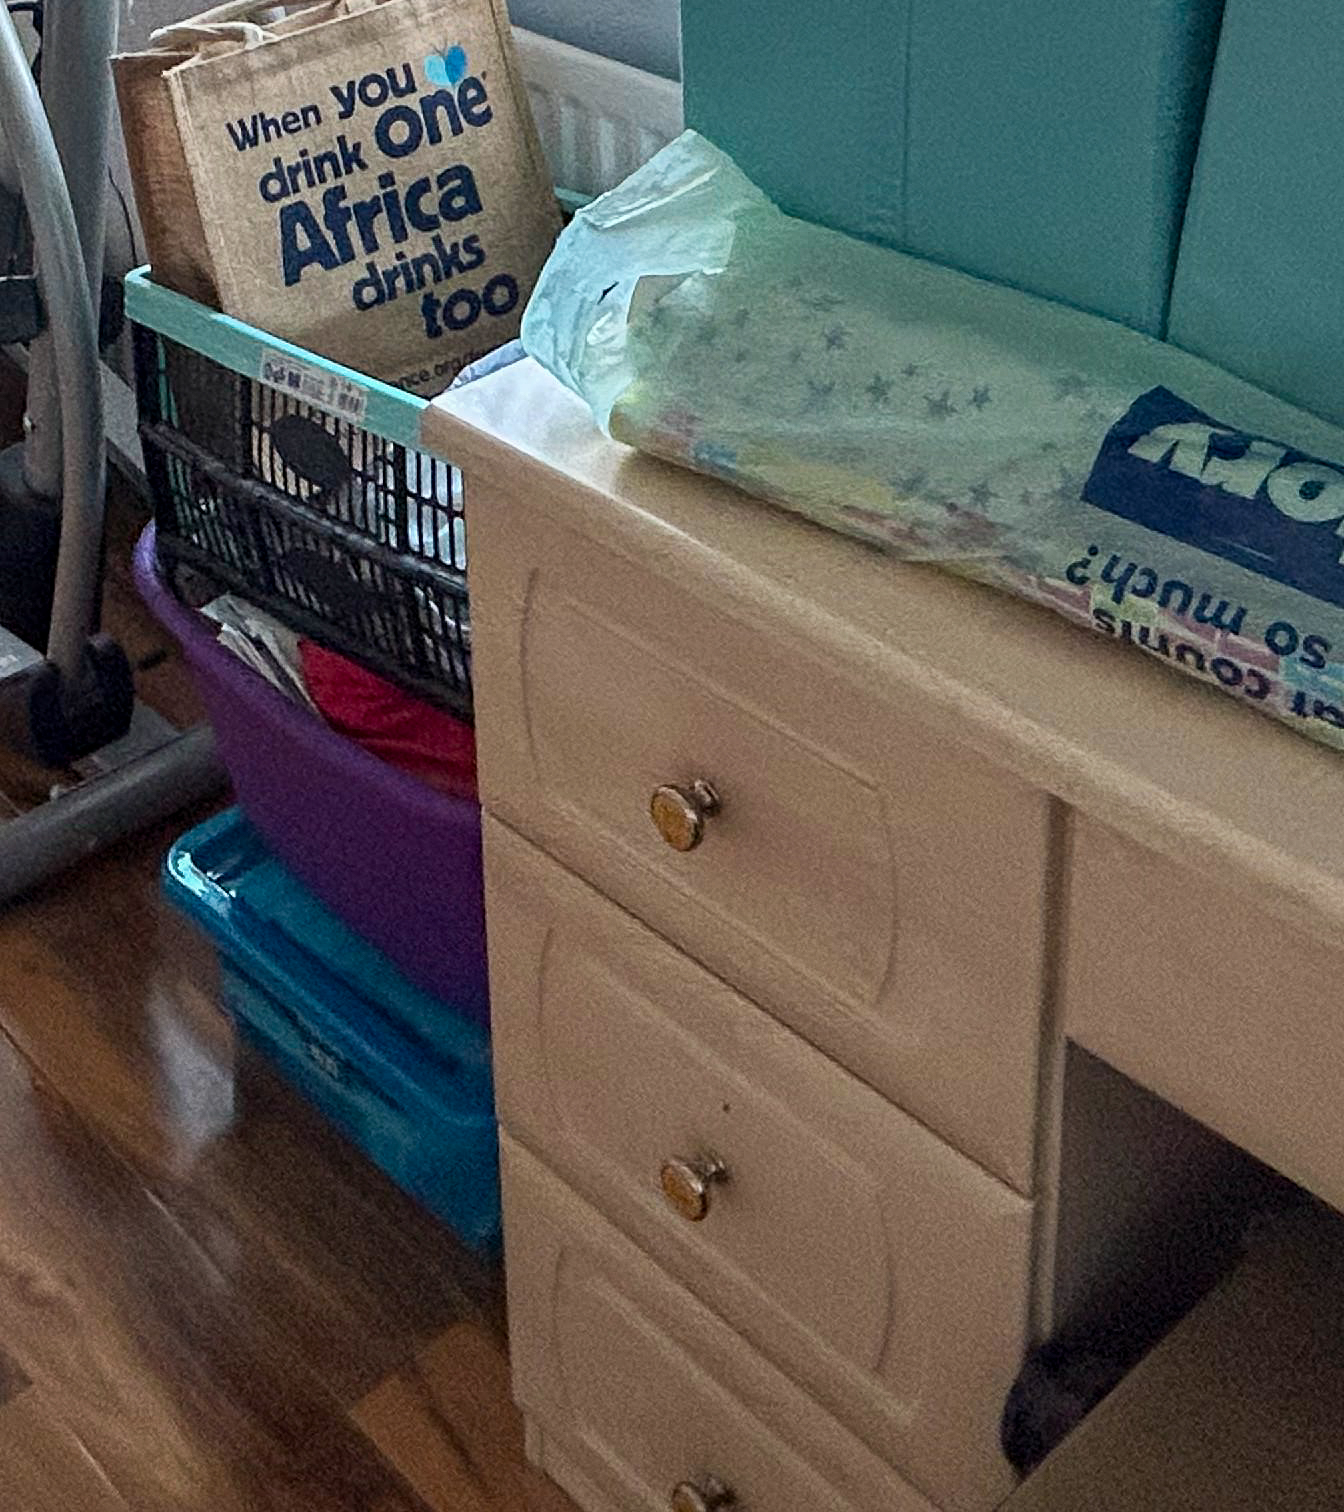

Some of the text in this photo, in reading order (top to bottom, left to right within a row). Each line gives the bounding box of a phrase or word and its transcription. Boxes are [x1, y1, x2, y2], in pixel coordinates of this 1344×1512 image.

[225, 62, 419, 152] When you
[258, 74, 494, 204] drink one
[278, 163, 485, 288] Africa
[351, 232, 487, 312] drinks
[420, 272, 520, 340] too
[1064, 545, 1250, 637] much?
[1091, 606, 1272, 701] counts
[1263, 620, 1331, 671] so
